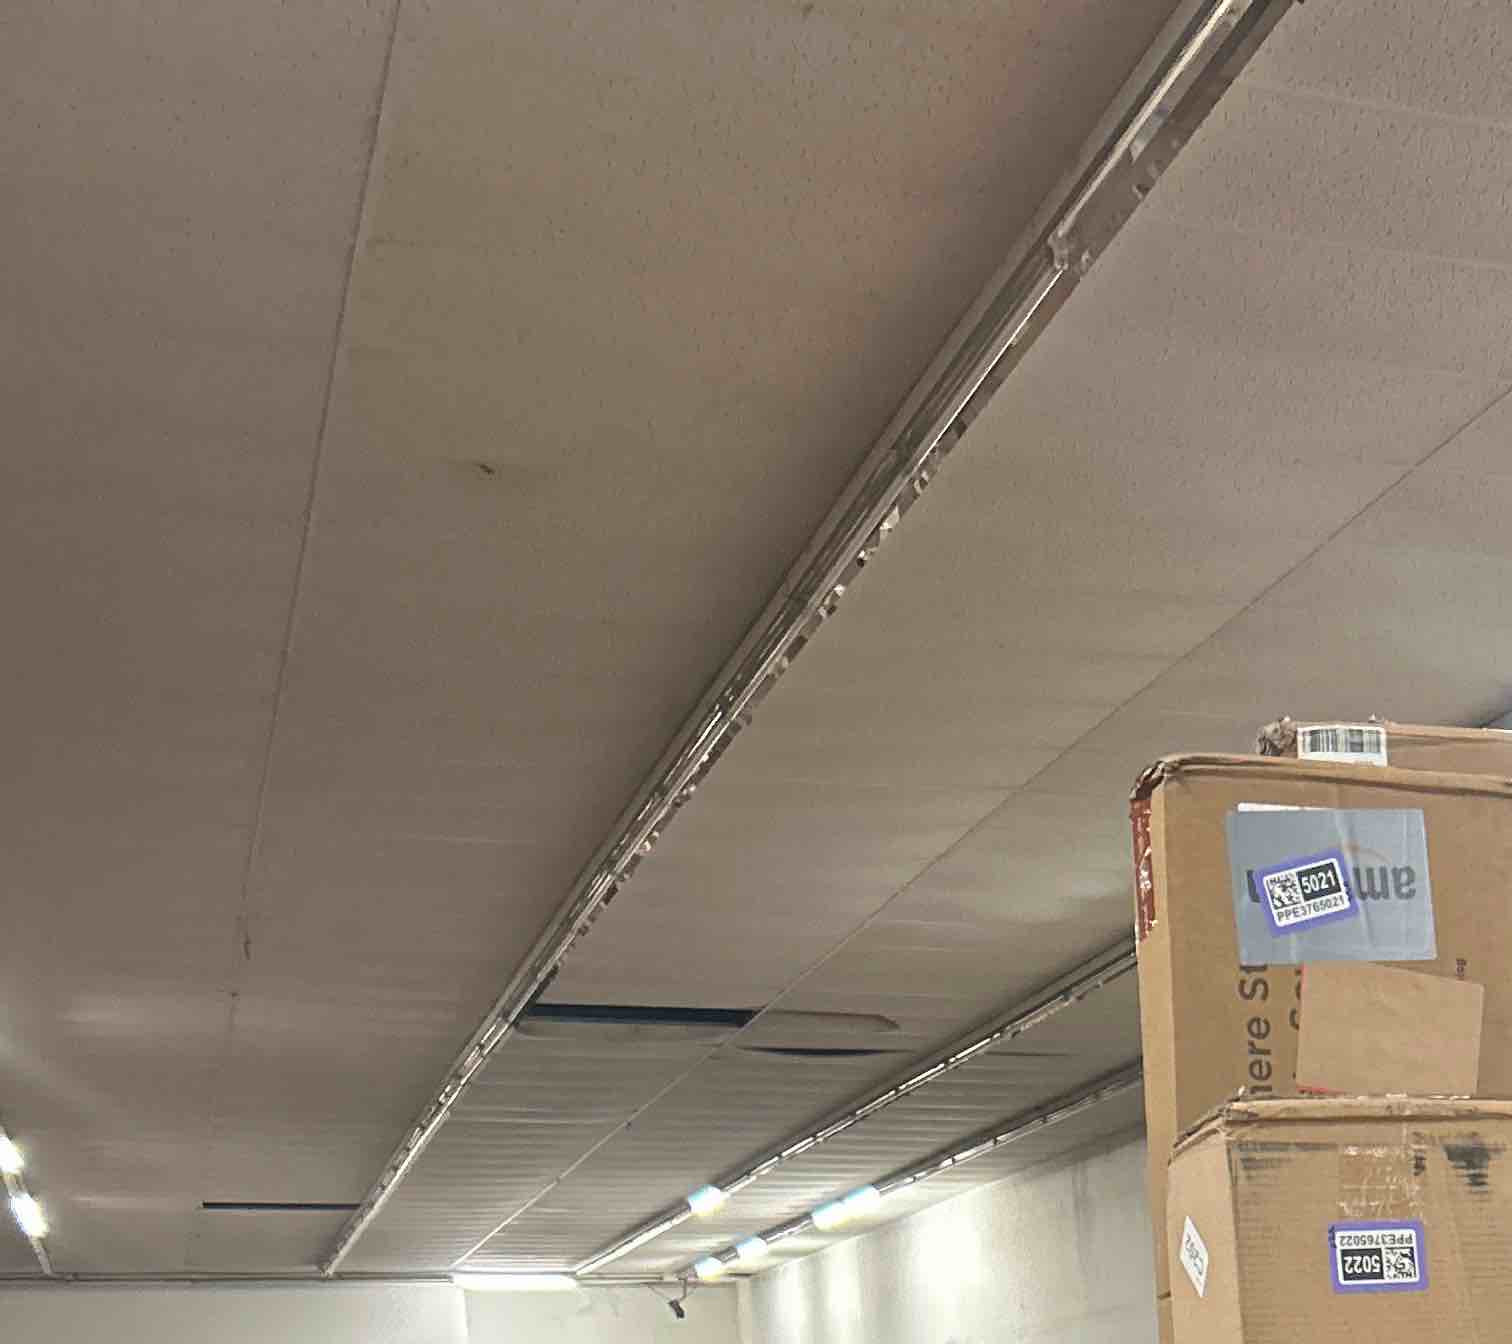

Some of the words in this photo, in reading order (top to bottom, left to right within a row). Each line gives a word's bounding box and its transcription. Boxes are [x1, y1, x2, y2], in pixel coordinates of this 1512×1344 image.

[1303, 870, 1337, 894] 5021
[1277, 895, 1345, 922] PPE3765021
[1337, 1231, 1414, 1248] PPE3765022
[1344, 1255, 1381, 1276] 5022
